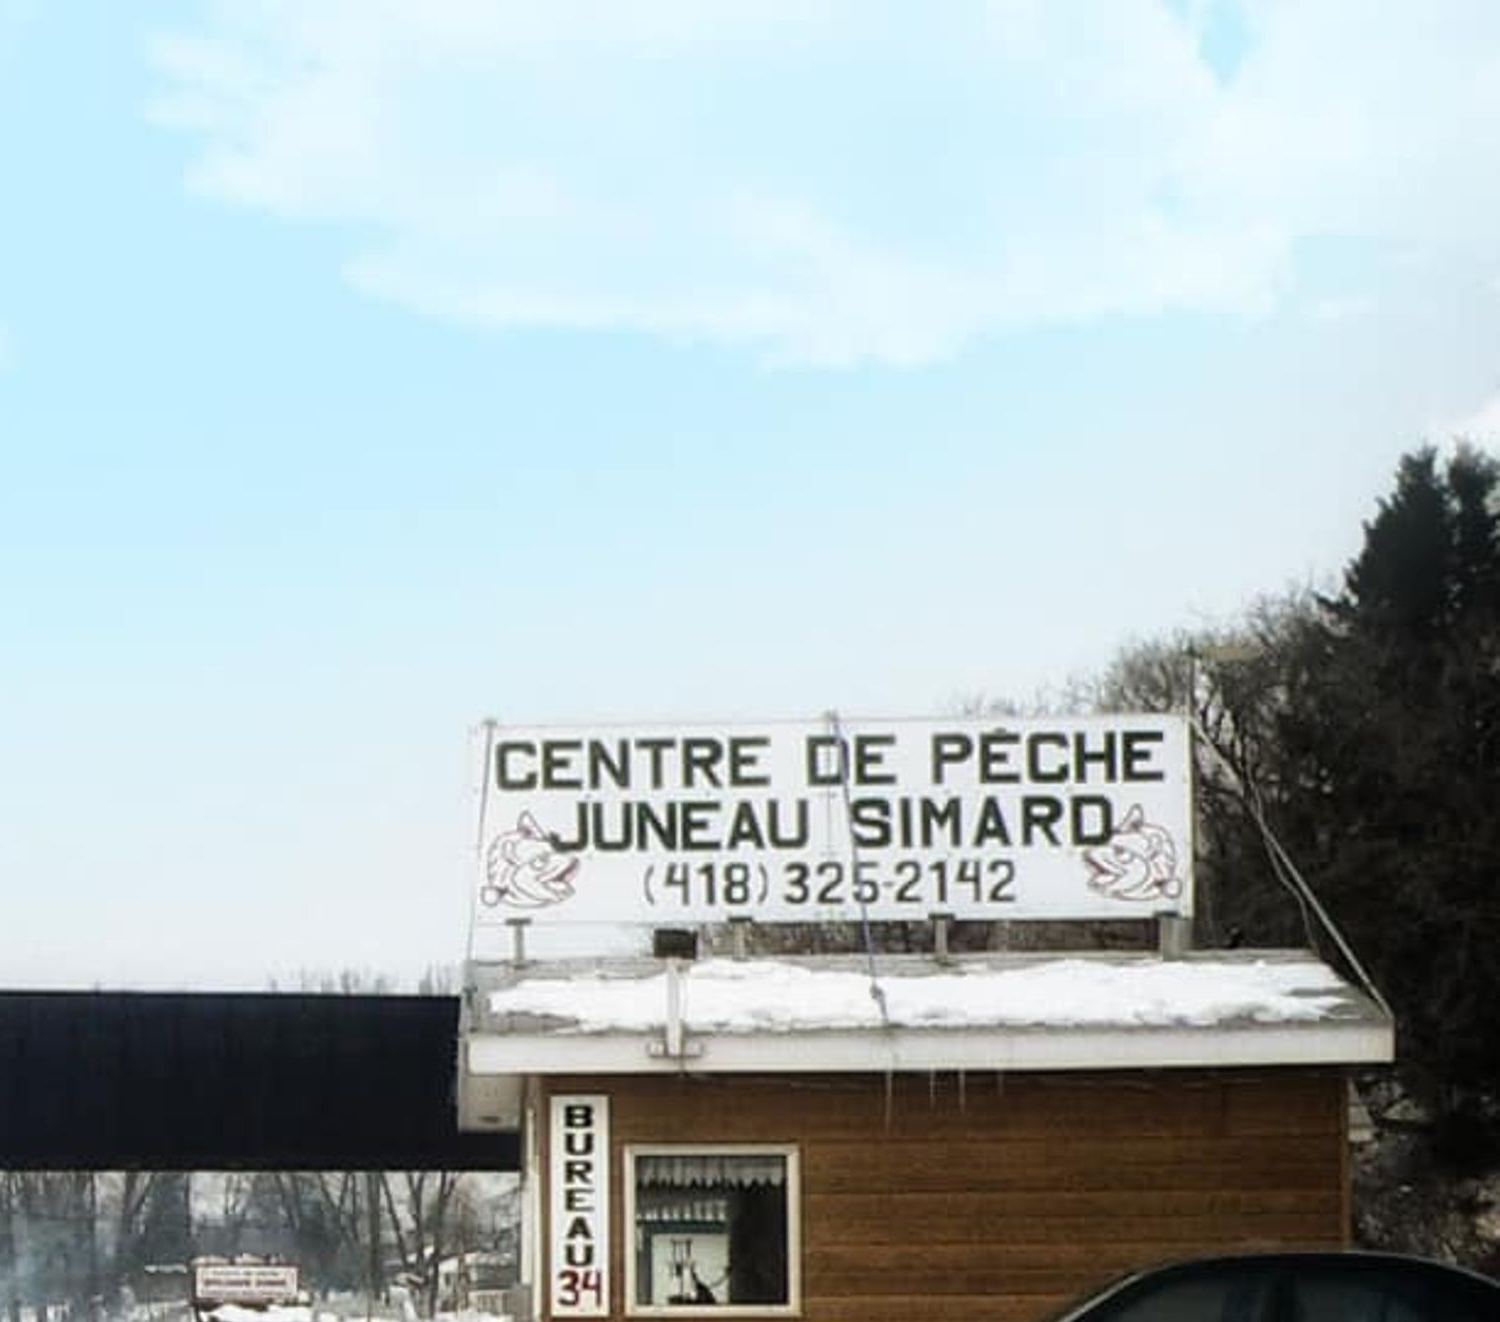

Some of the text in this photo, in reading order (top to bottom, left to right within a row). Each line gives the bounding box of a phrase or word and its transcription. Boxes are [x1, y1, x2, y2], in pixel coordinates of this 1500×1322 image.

[496, 727, 1164, 790] CENTRE DE PÊCHE
[550, 795, 1113, 850] JUNEAU SIMARD
[644, 860, 1015, 906] (418) 325-2142
[565, 1104, 594, 1267] BUREAU
[558, 1270, 602, 1307] 34
